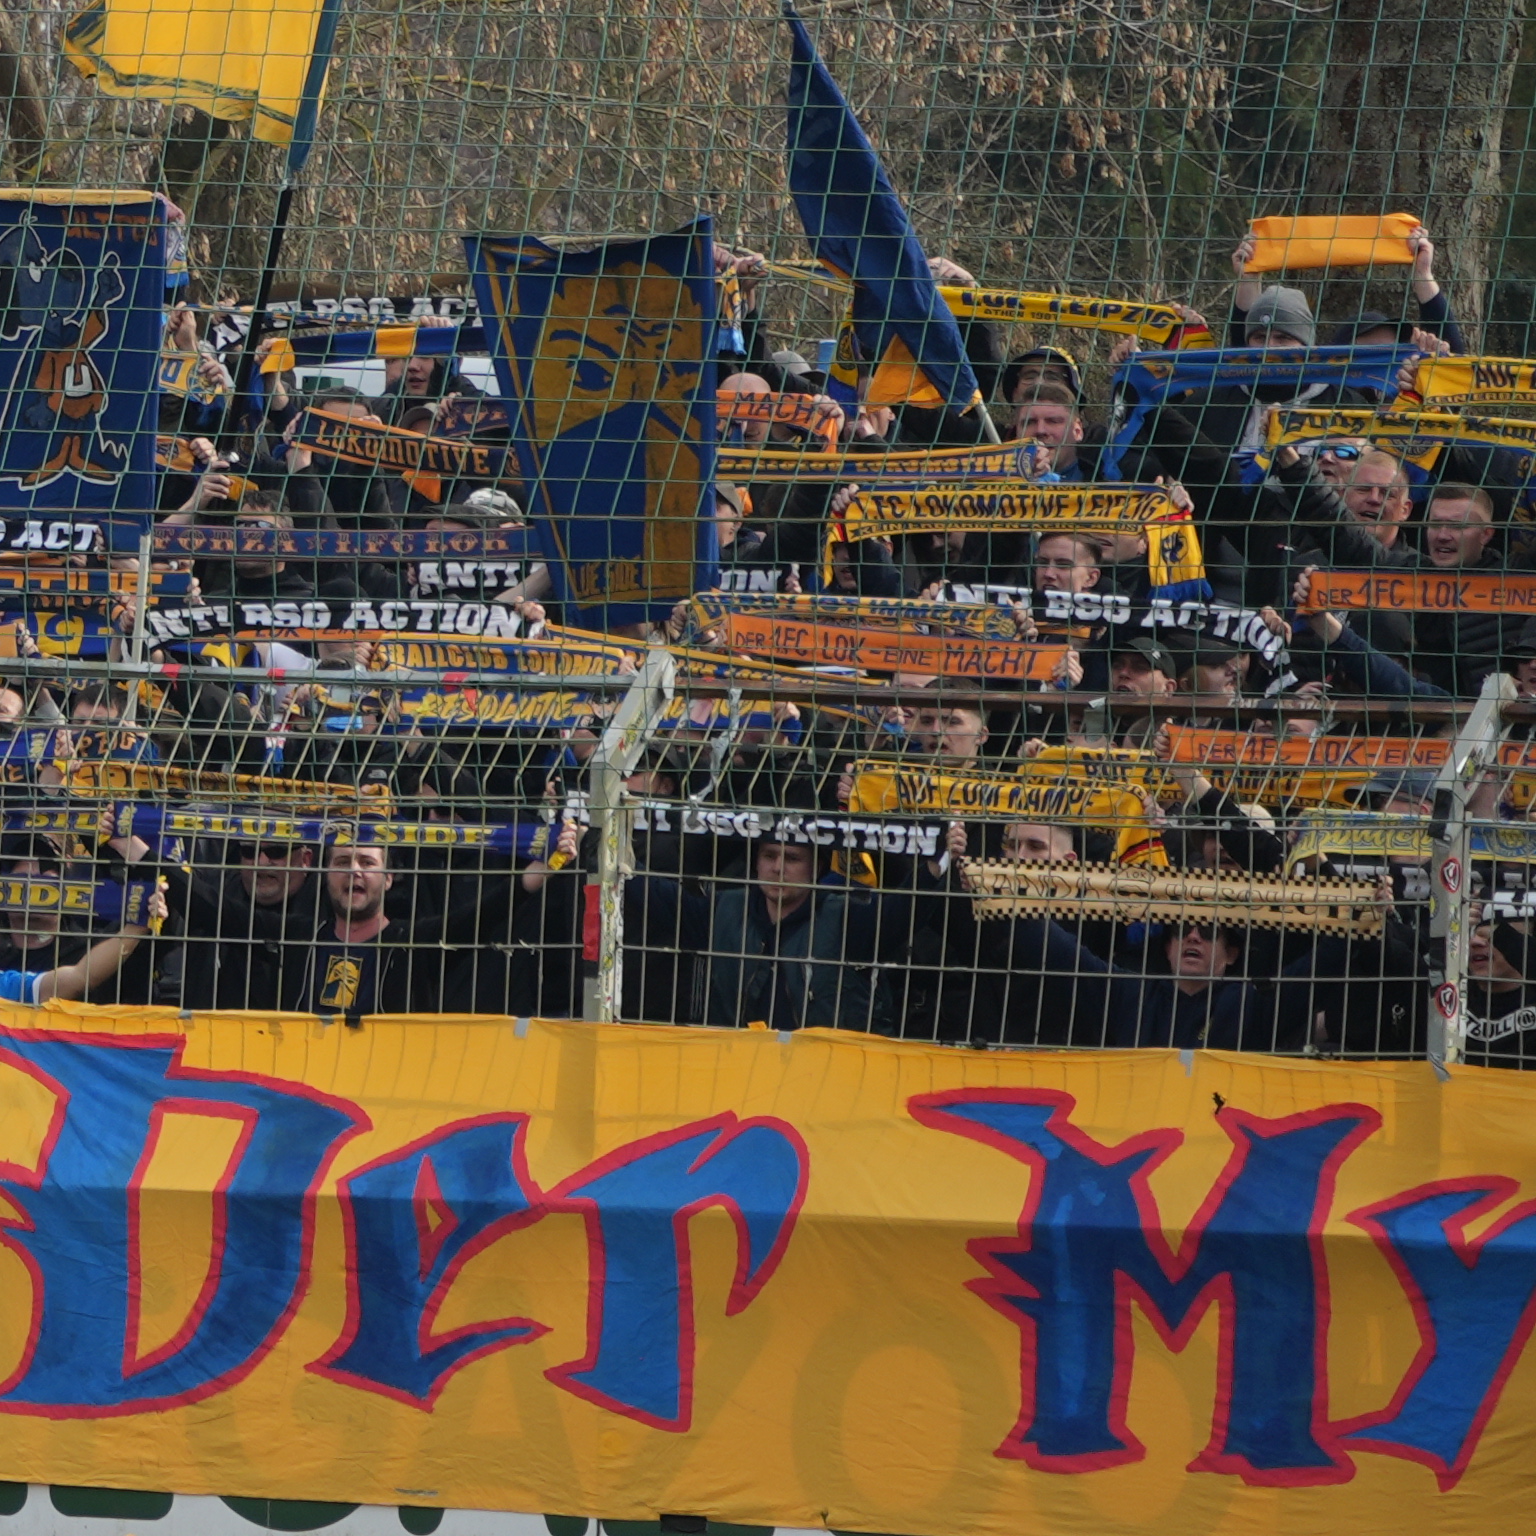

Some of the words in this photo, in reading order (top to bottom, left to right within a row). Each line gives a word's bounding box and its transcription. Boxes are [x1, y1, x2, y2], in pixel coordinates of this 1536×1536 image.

[961, 291, 1026, 310] LOK
[1049, 300, 1177, 329] LEIPZIG
[1474, 364, 1518, 390] AUF
[316, 419, 491, 475] LOKOMOTIVE
[913, 492, 1071, 520] LOKOMOTIVE
[1077, 491, 1164, 523] LEIPZIG
[11, 520, 101, 552] ACT
[1317, 588, 1354, 607] DER
[1422, 580, 1471, 609] LOK
[1490, 588, 1536, 607] EINE
[148, 601, 232, 642] NTI
[244, 601, 332, 629] BSG
[342, 600, 523, 639] ACTION
[1045, 589, 1131, 625] BSG
[1141, 599, 1290, 662] ACTIO
[378, 641, 509, 672] SBALLCLUB
[735, 630, 765, 649] DER
[822, 632, 865, 663] LOK
[883, 646, 929, 668] EINE
[943, 641, 1044, 677] MACHT
[1197, 742, 1236, 762] DER
[1310, 740, 1364, 765] LOK
[896, 774, 940, 806] AUF
[947, 781, 1000, 807] ZUM
[24, 810, 102, 833] SID
[171, 814, 302, 842] BLUE
[373, 822, 492, 849] SIDE
[773, 816, 941, 857] ACTION
